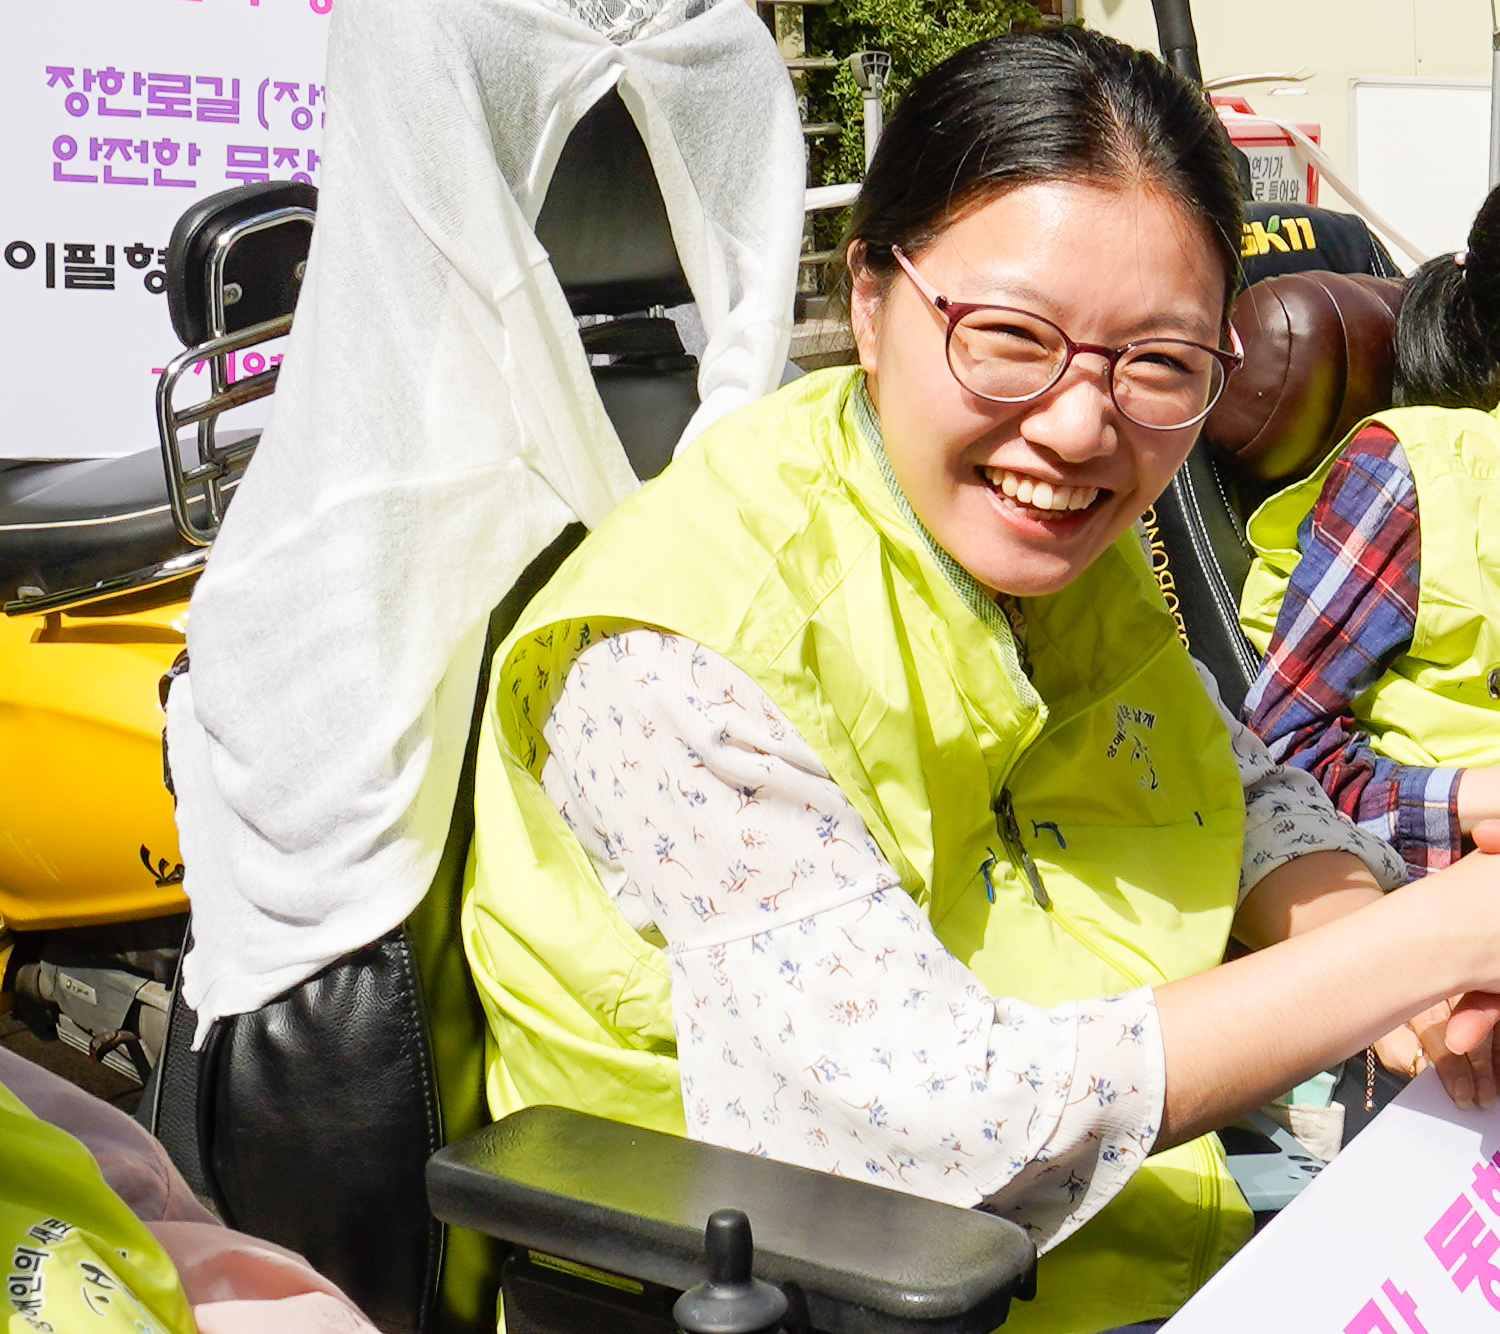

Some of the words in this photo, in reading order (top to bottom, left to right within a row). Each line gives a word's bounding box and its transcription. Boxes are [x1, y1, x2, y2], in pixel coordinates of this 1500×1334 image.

[46, 65, 240, 125] 장한로길
[258, 77, 326, 131] (장
[52, 134, 201, 187] 안전한
